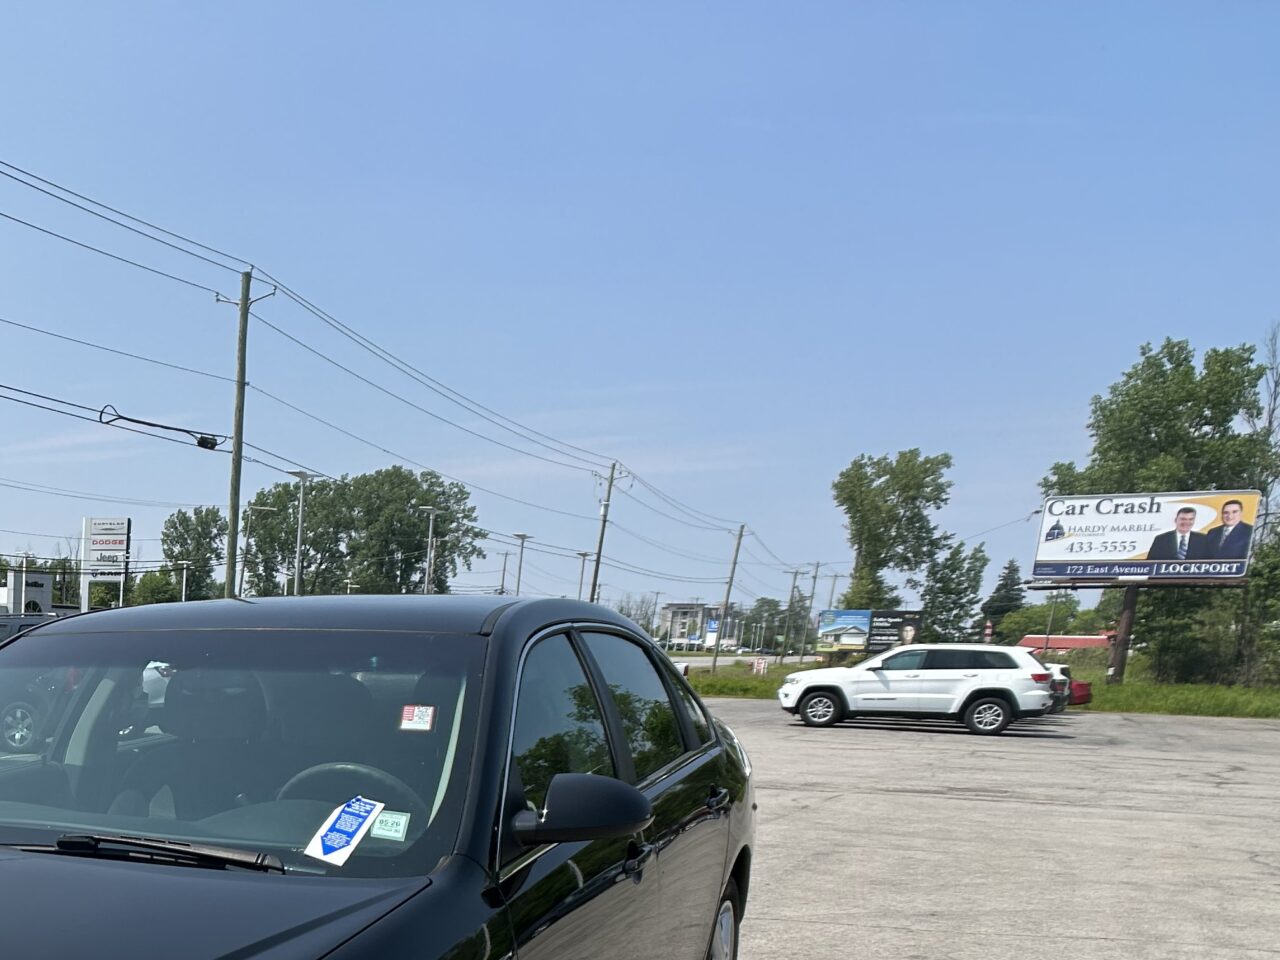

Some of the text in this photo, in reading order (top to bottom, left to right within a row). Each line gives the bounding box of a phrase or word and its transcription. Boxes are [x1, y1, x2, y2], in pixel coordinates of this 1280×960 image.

[1048, 496, 1162, 517] Car Crash
[1067, 523, 1155, 534] HARDY MARBLE
[1065, 540, 1137, 553] 433-5555
[96, 552, 118, 562] Jeep
[1065, 564, 1083, 574] 172
[1086, 564, 1108, 574] East
[1110, 564, 1150, 574] Avenue
[1159, 562, 1241, 574] LOCKPORT
